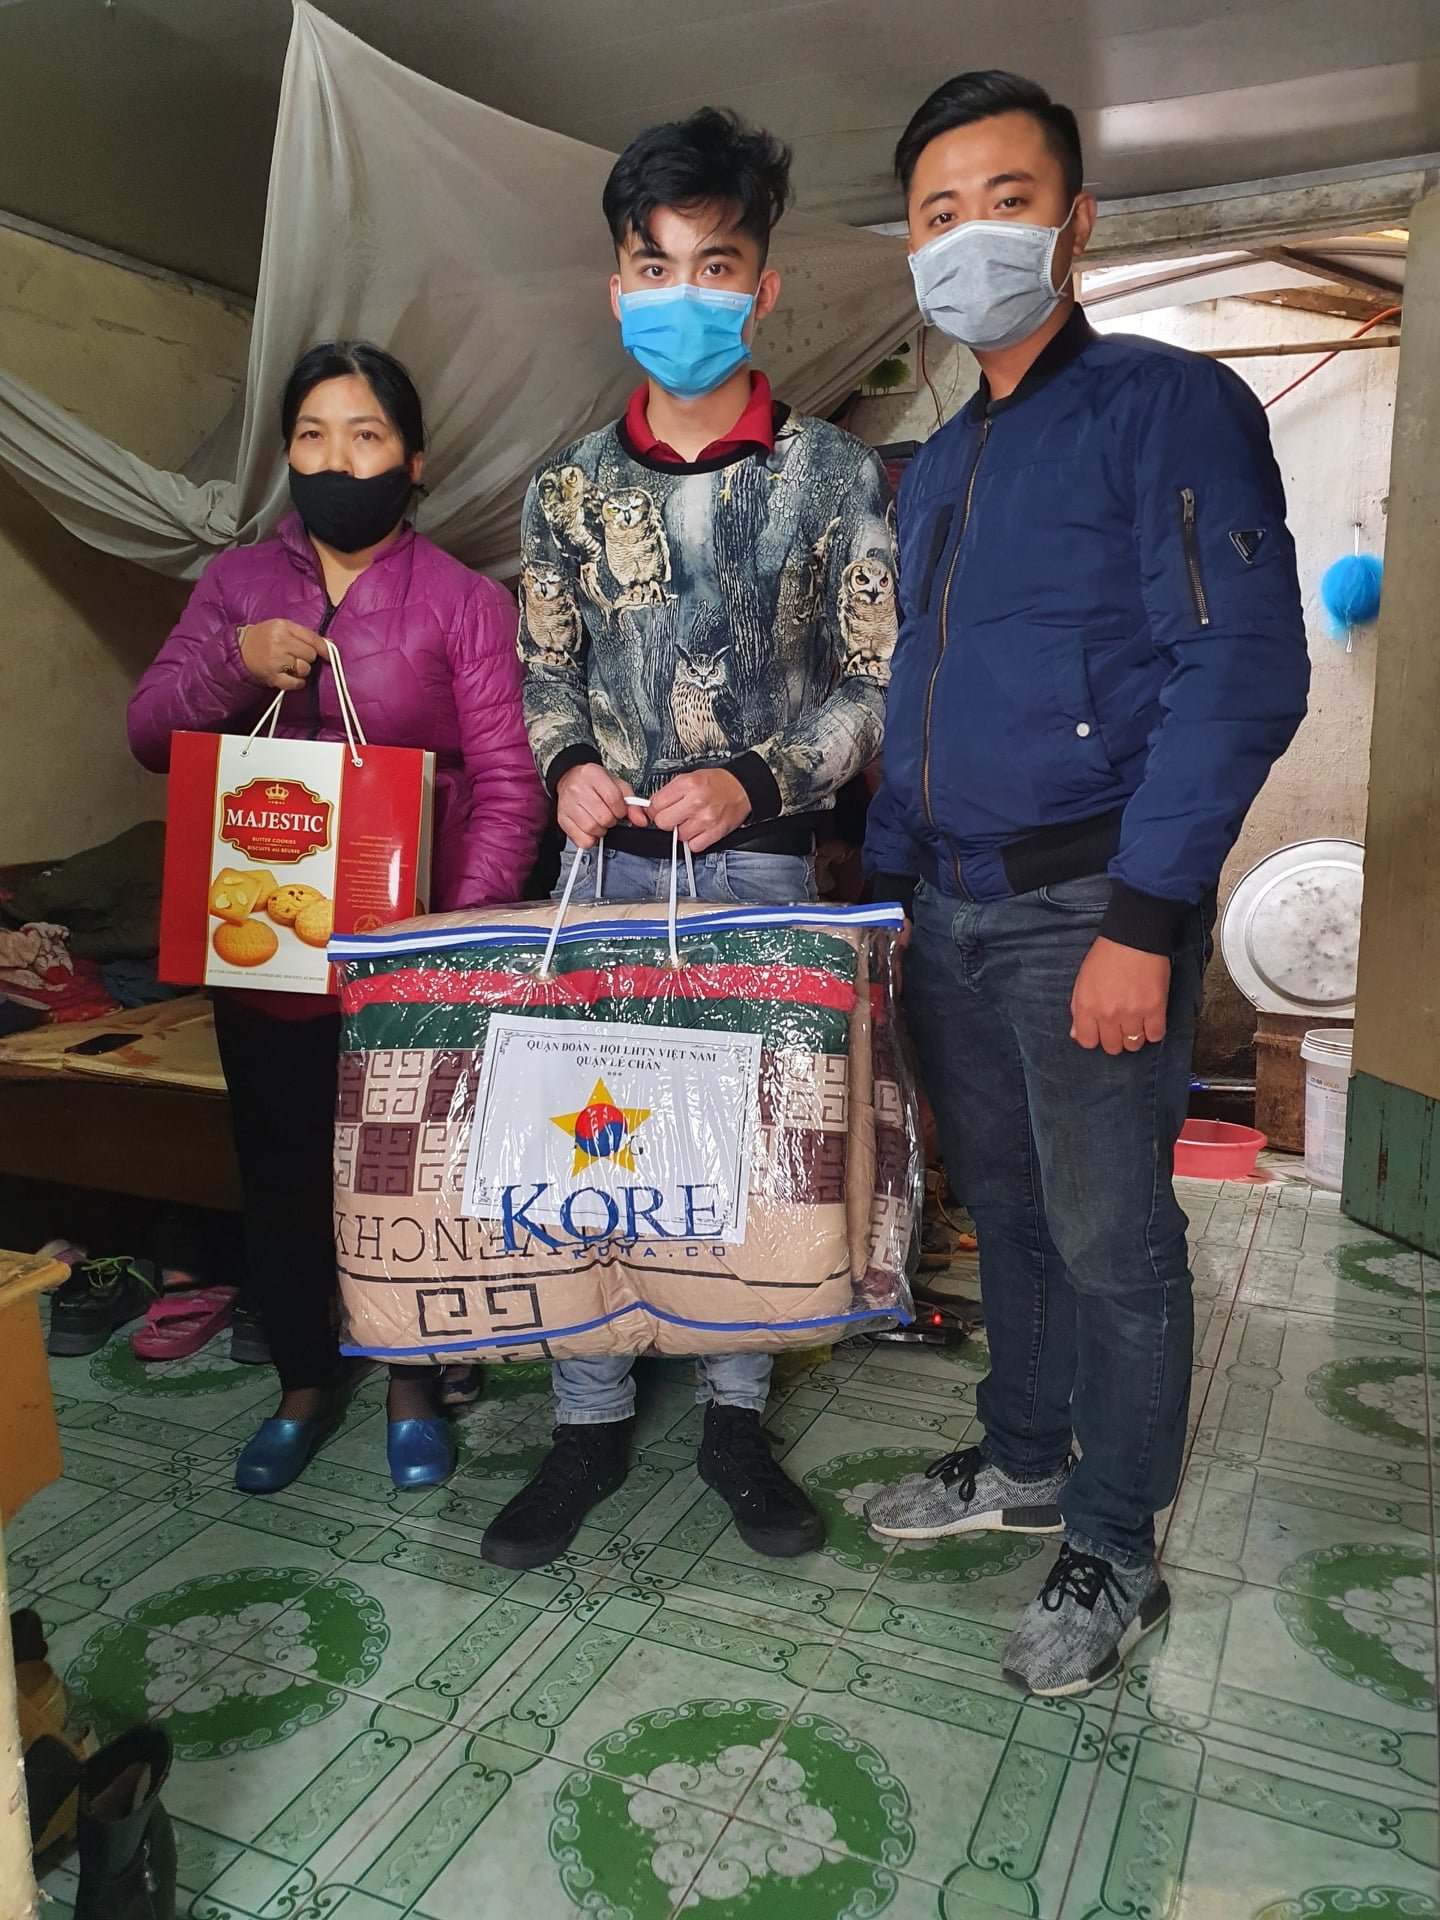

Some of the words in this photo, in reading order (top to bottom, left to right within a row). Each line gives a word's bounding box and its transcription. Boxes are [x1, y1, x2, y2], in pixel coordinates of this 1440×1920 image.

[225, 808, 324, 833] MAJESTIC
[600, 1043, 621, 1056] HỘI
[624, 1045, 656, 1057] LHTN
[689, 1051, 717, 1063] NAM
[491, 1183, 725, 1252] KORE
